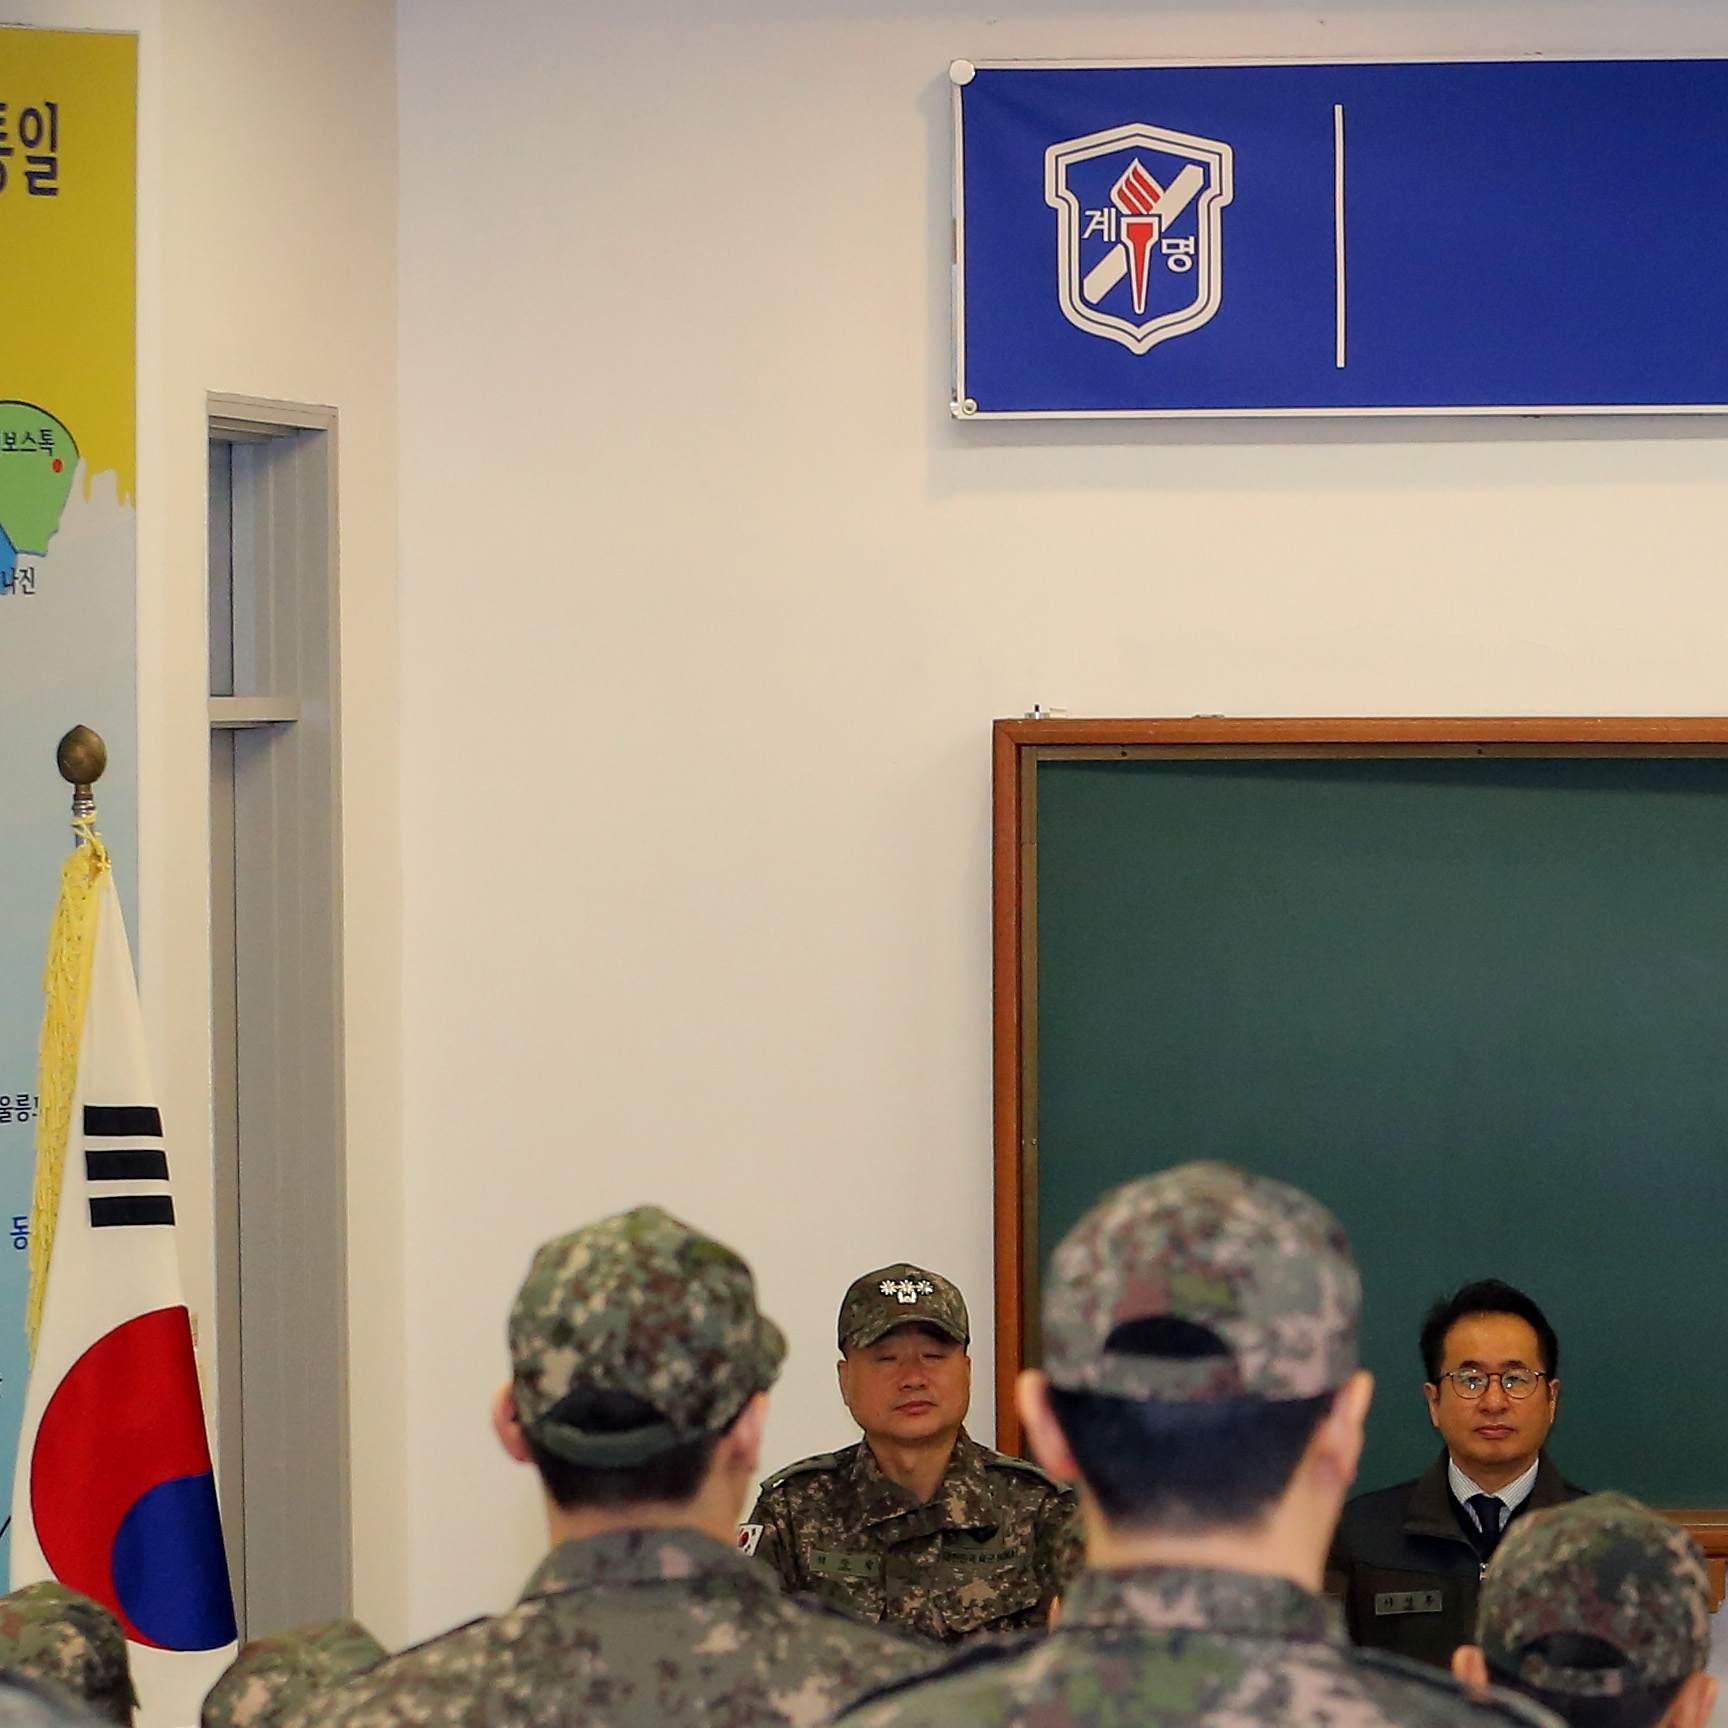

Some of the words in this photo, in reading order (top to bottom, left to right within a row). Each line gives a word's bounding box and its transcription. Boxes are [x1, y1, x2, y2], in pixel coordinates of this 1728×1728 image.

[1081, 206, 1117, 243] 계
[1160, 235, 1196, 273] 명
[0, 566, 36, 596] 나진
[0, 1093, 40, 1123] 울릉
